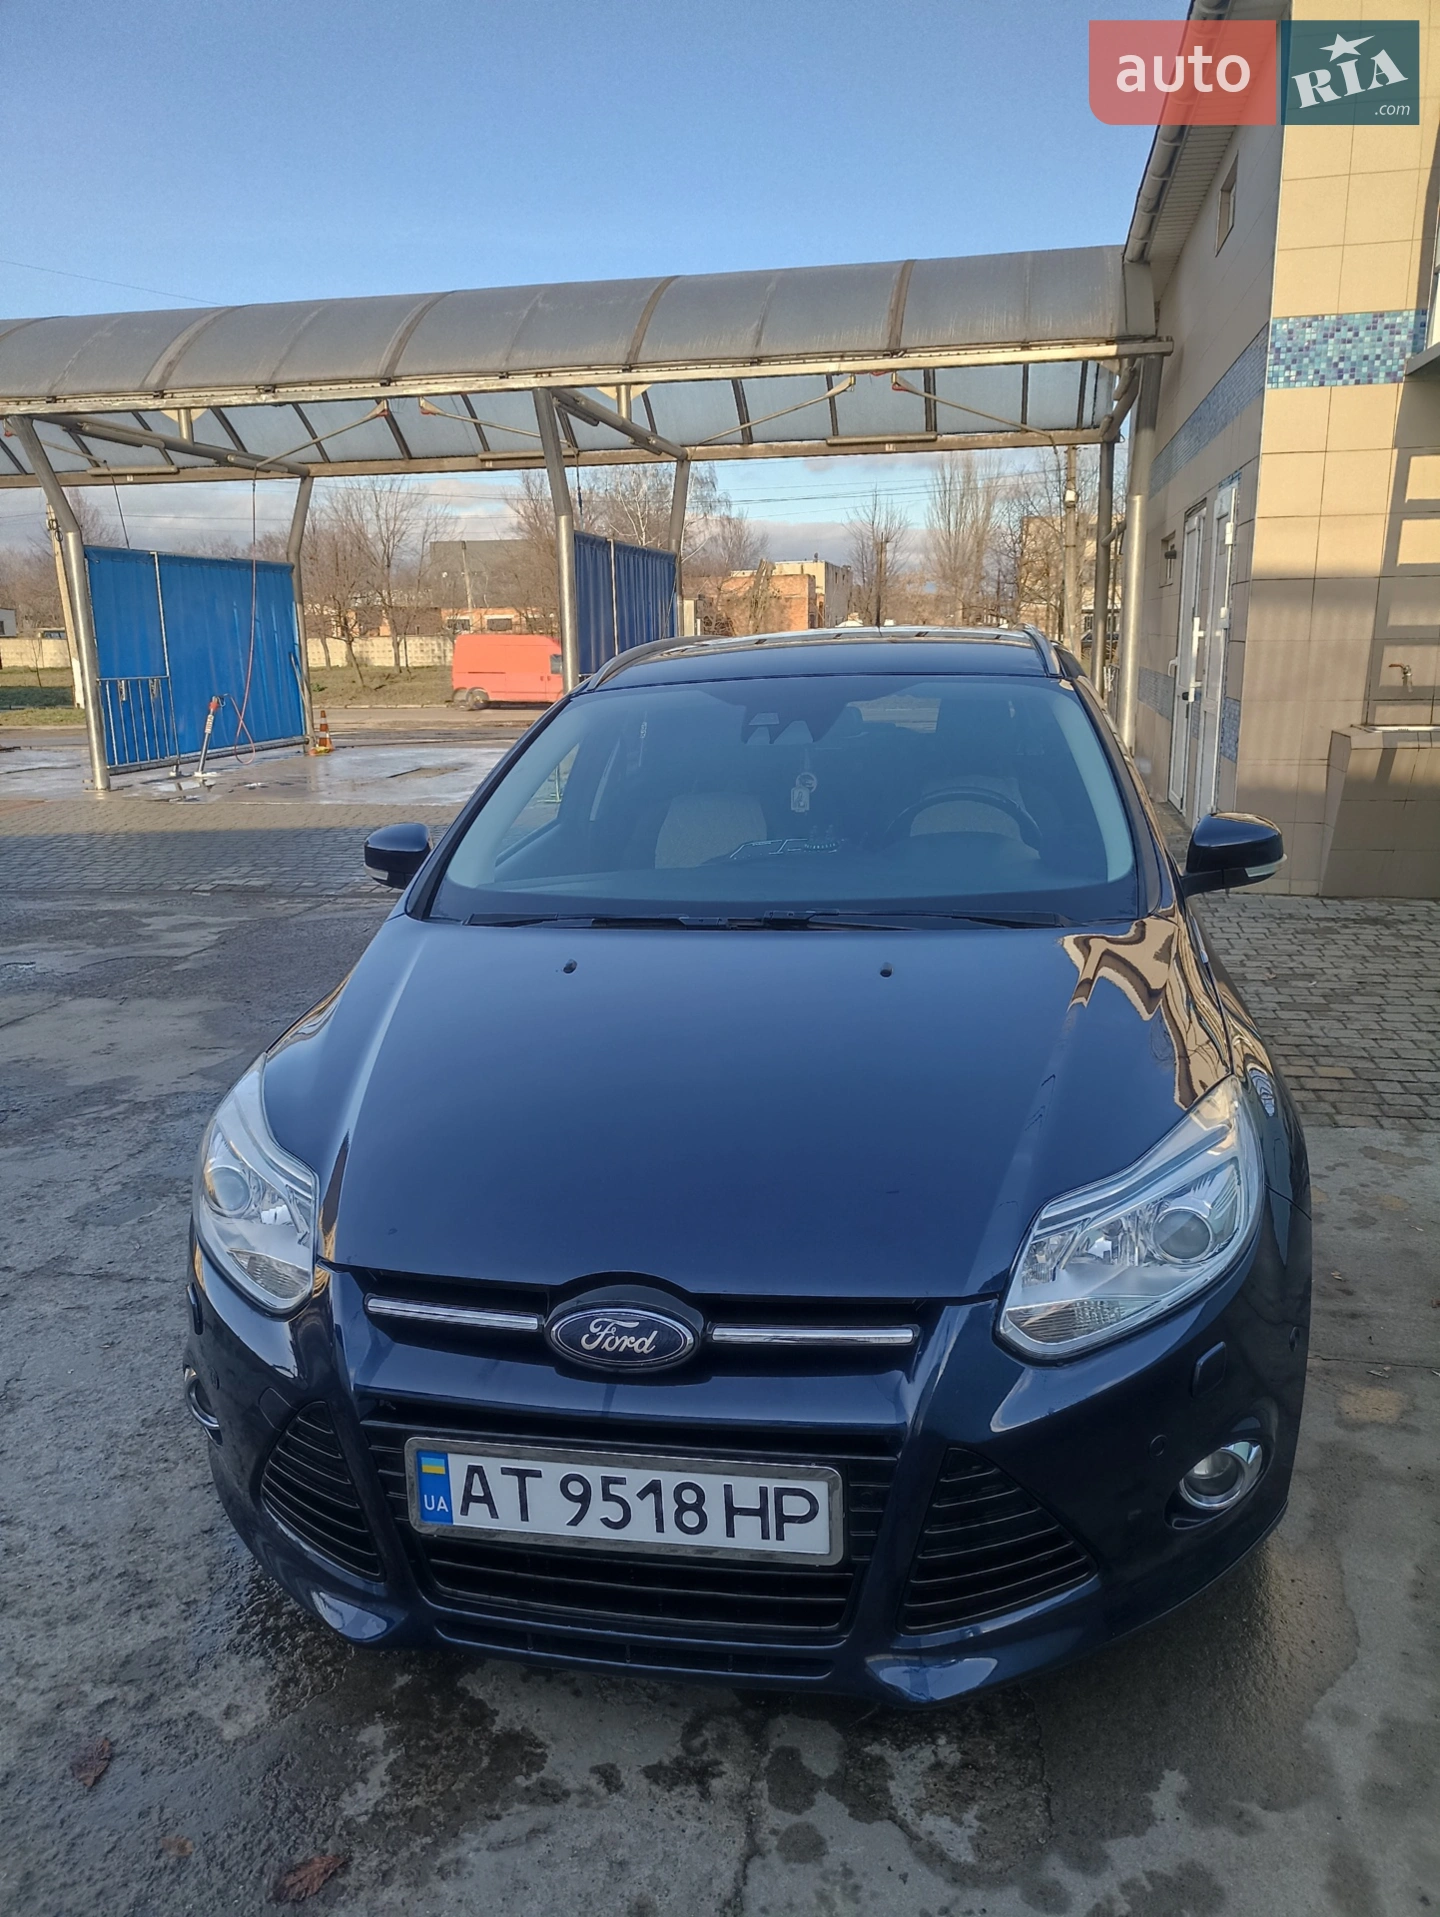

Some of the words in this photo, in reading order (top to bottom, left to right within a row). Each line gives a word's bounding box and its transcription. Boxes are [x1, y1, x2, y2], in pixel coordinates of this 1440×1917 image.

[580, 1317, 658, 1354] Ford
[423, 1494, 449, 1512] UA
[459, 1464, 542, 1522] AT
[559, 1473, 708, 1535] 9518
[723, 1484, 820, 1541] HP
